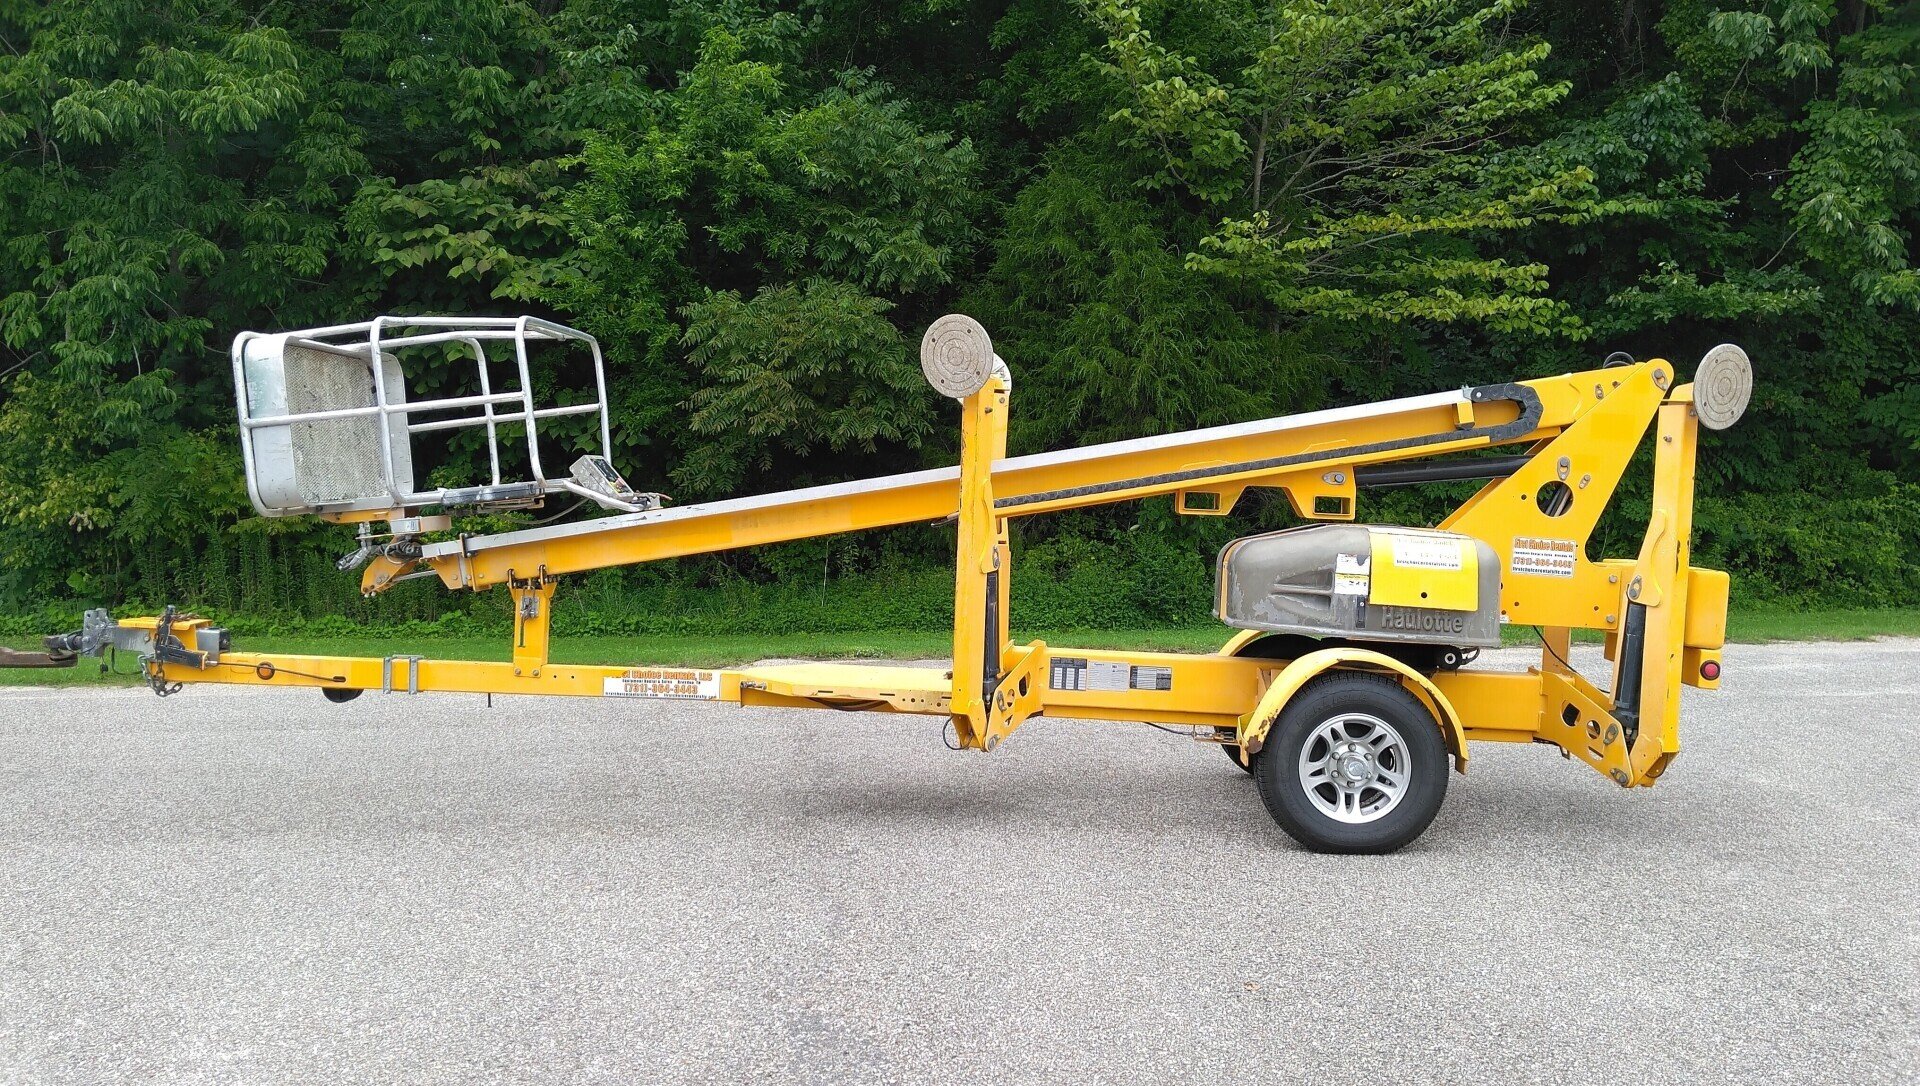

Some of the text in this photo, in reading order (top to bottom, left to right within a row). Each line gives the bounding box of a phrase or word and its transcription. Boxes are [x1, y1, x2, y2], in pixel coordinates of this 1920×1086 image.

[1514, 538, 1573, 552] First Choice Rentals
[1381, 605, 1463, 633] Haulotte
[631, 670, 661, 680] Choice
[624, 683, 698, 694] (731)-364-3443
